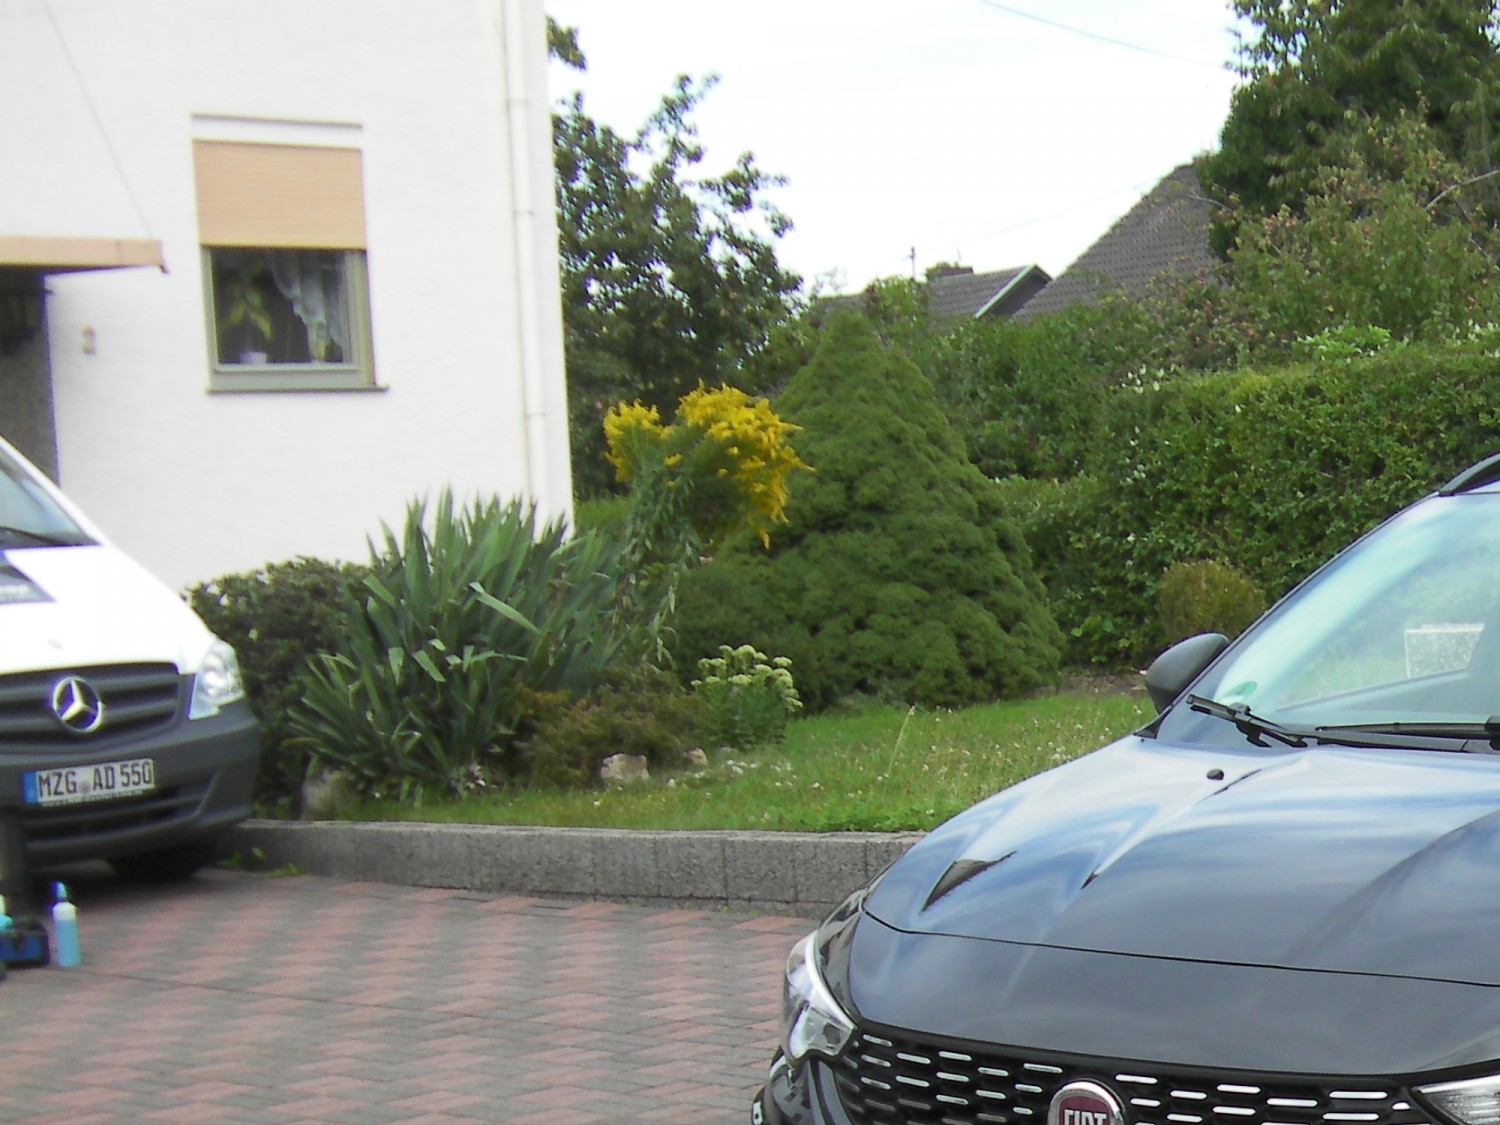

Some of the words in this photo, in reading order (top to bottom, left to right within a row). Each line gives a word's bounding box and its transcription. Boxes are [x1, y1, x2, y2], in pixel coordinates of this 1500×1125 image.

[38, 771, 77, 797] MZG
[92, 766, 116, 791] AD
[120, 760, 153, 787] 550
